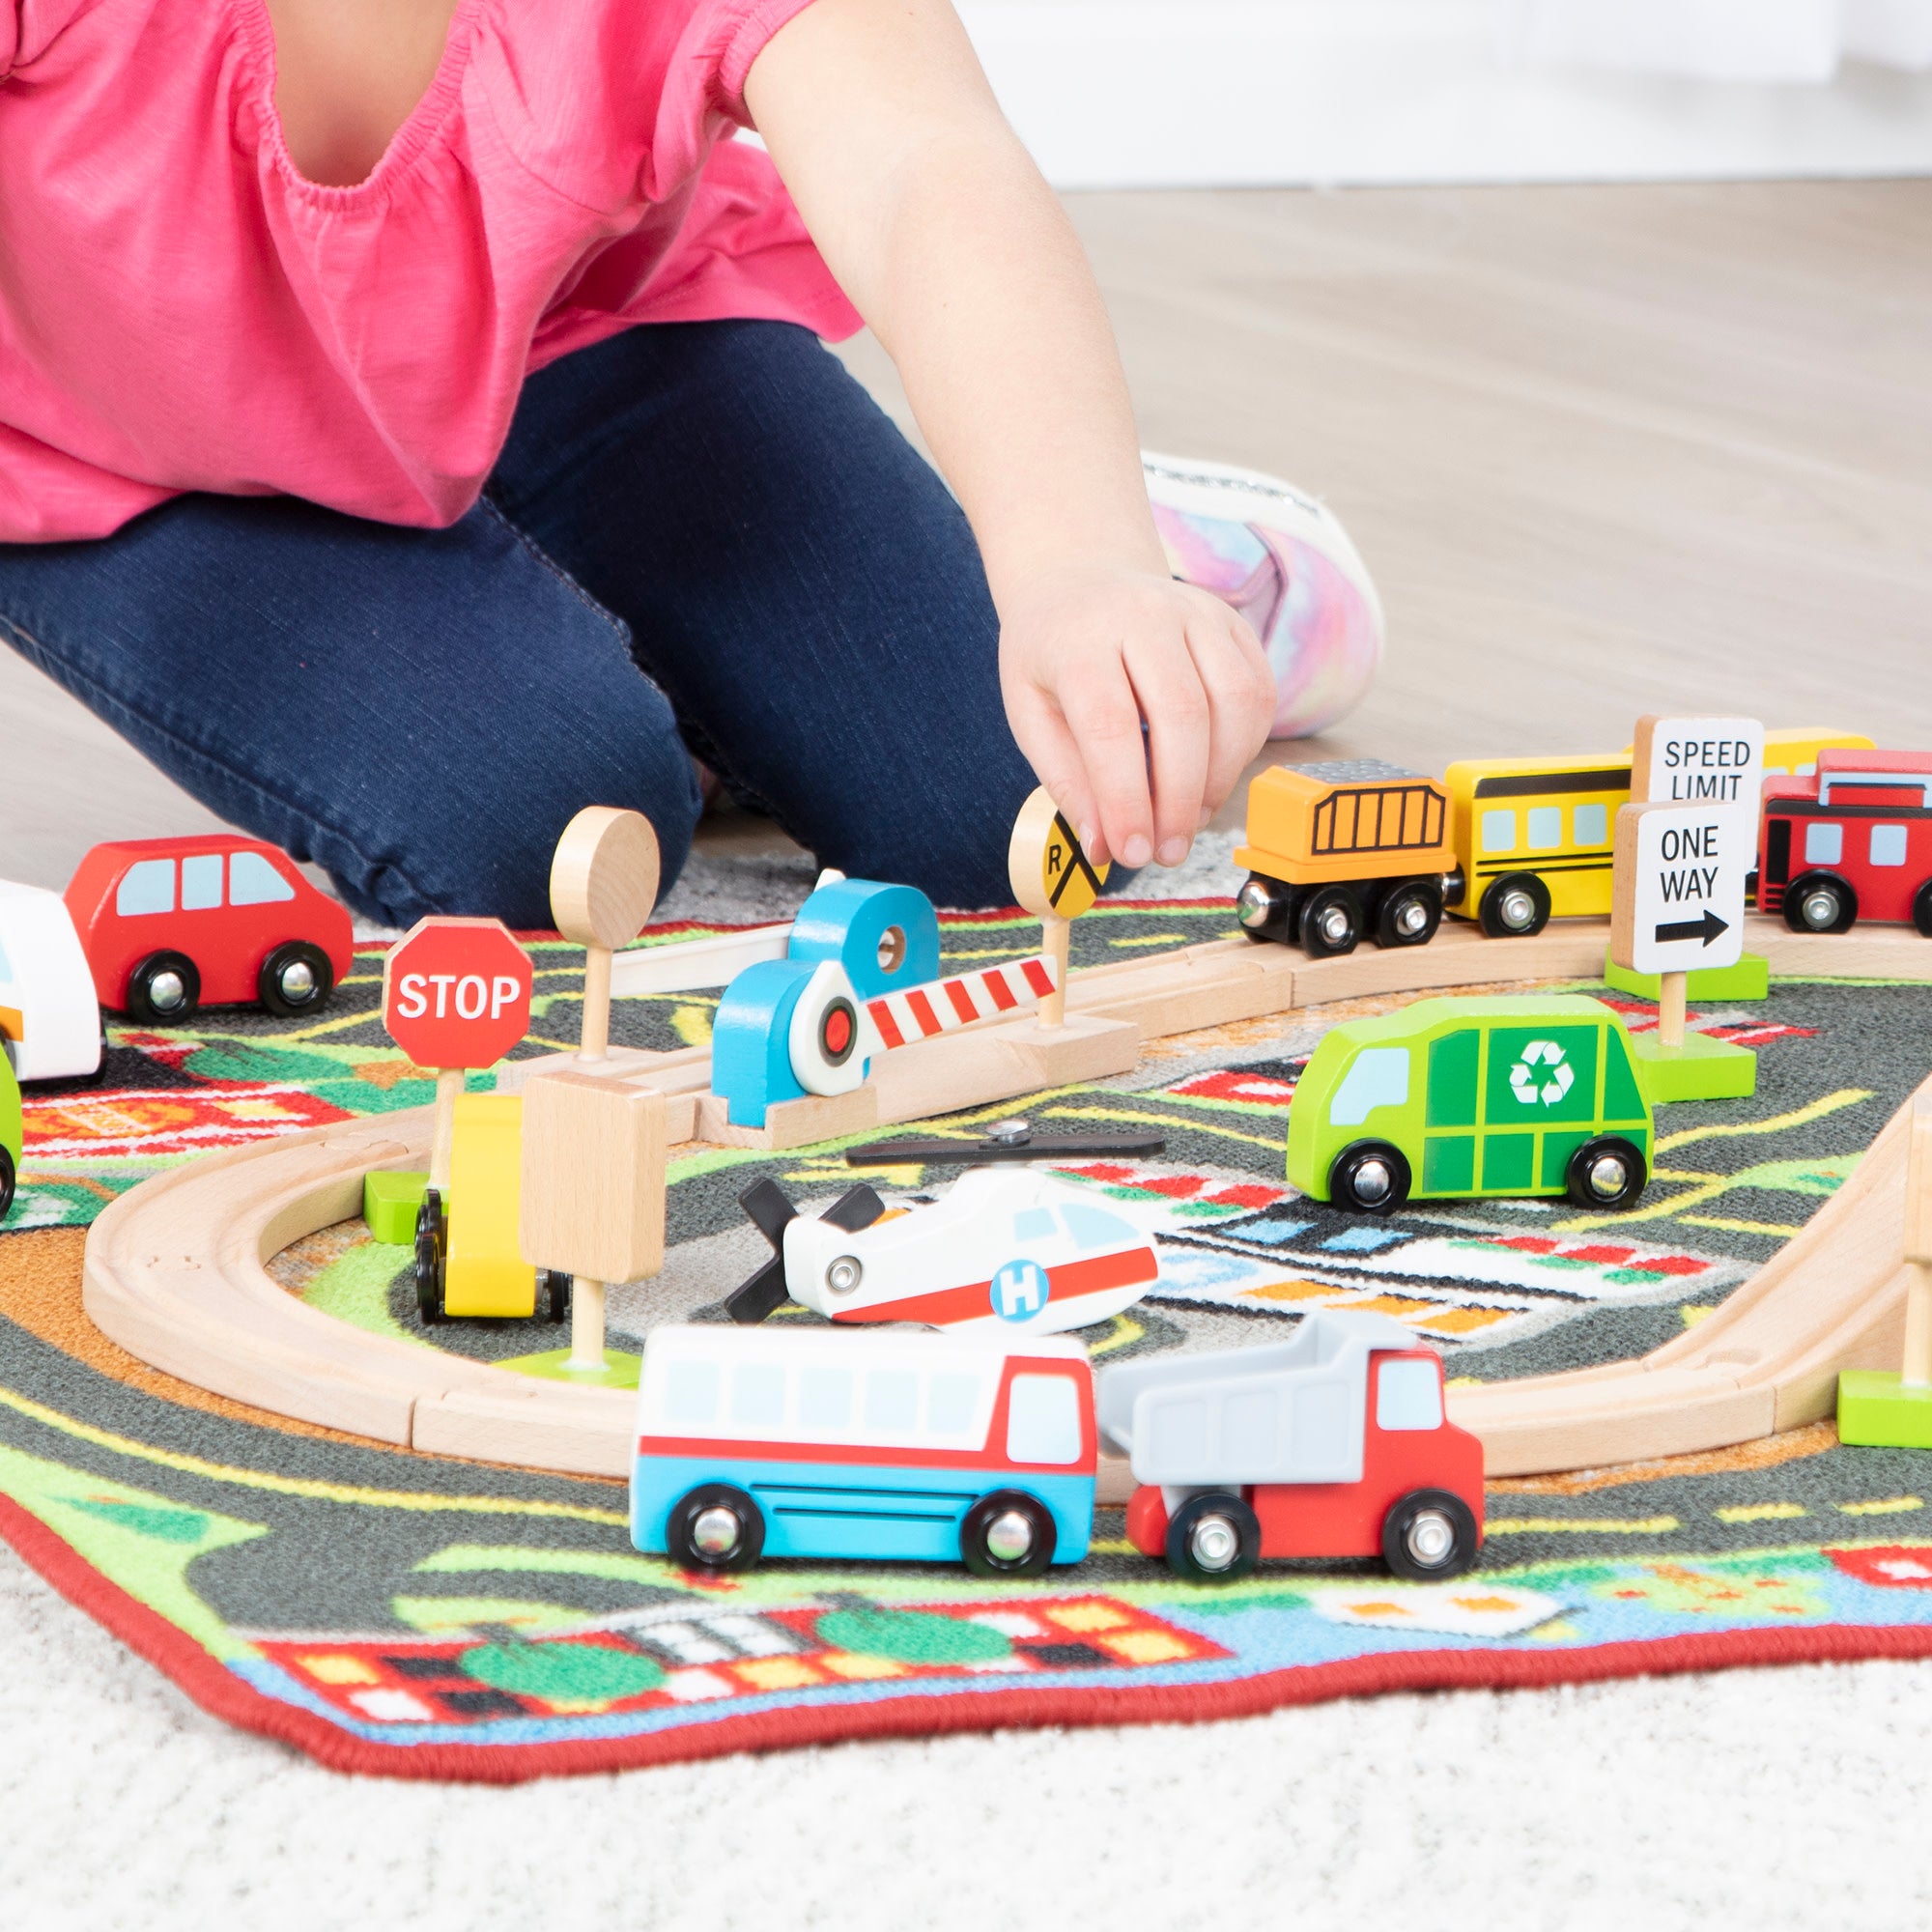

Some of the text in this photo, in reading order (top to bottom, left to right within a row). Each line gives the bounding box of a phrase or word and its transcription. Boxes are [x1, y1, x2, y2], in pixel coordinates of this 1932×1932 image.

[1664, 741, 1750, 768] SPEED
[1672, 775, 1743, 801] LIMIT
[1048, 844, 1062, 875] R
[1662, 826, 1719, 862] ONE
[1660, 867, 1719, 903] WAY
[397, 974, 521, 1020] STOP
[1000, 1264, 1039, 1317] H
